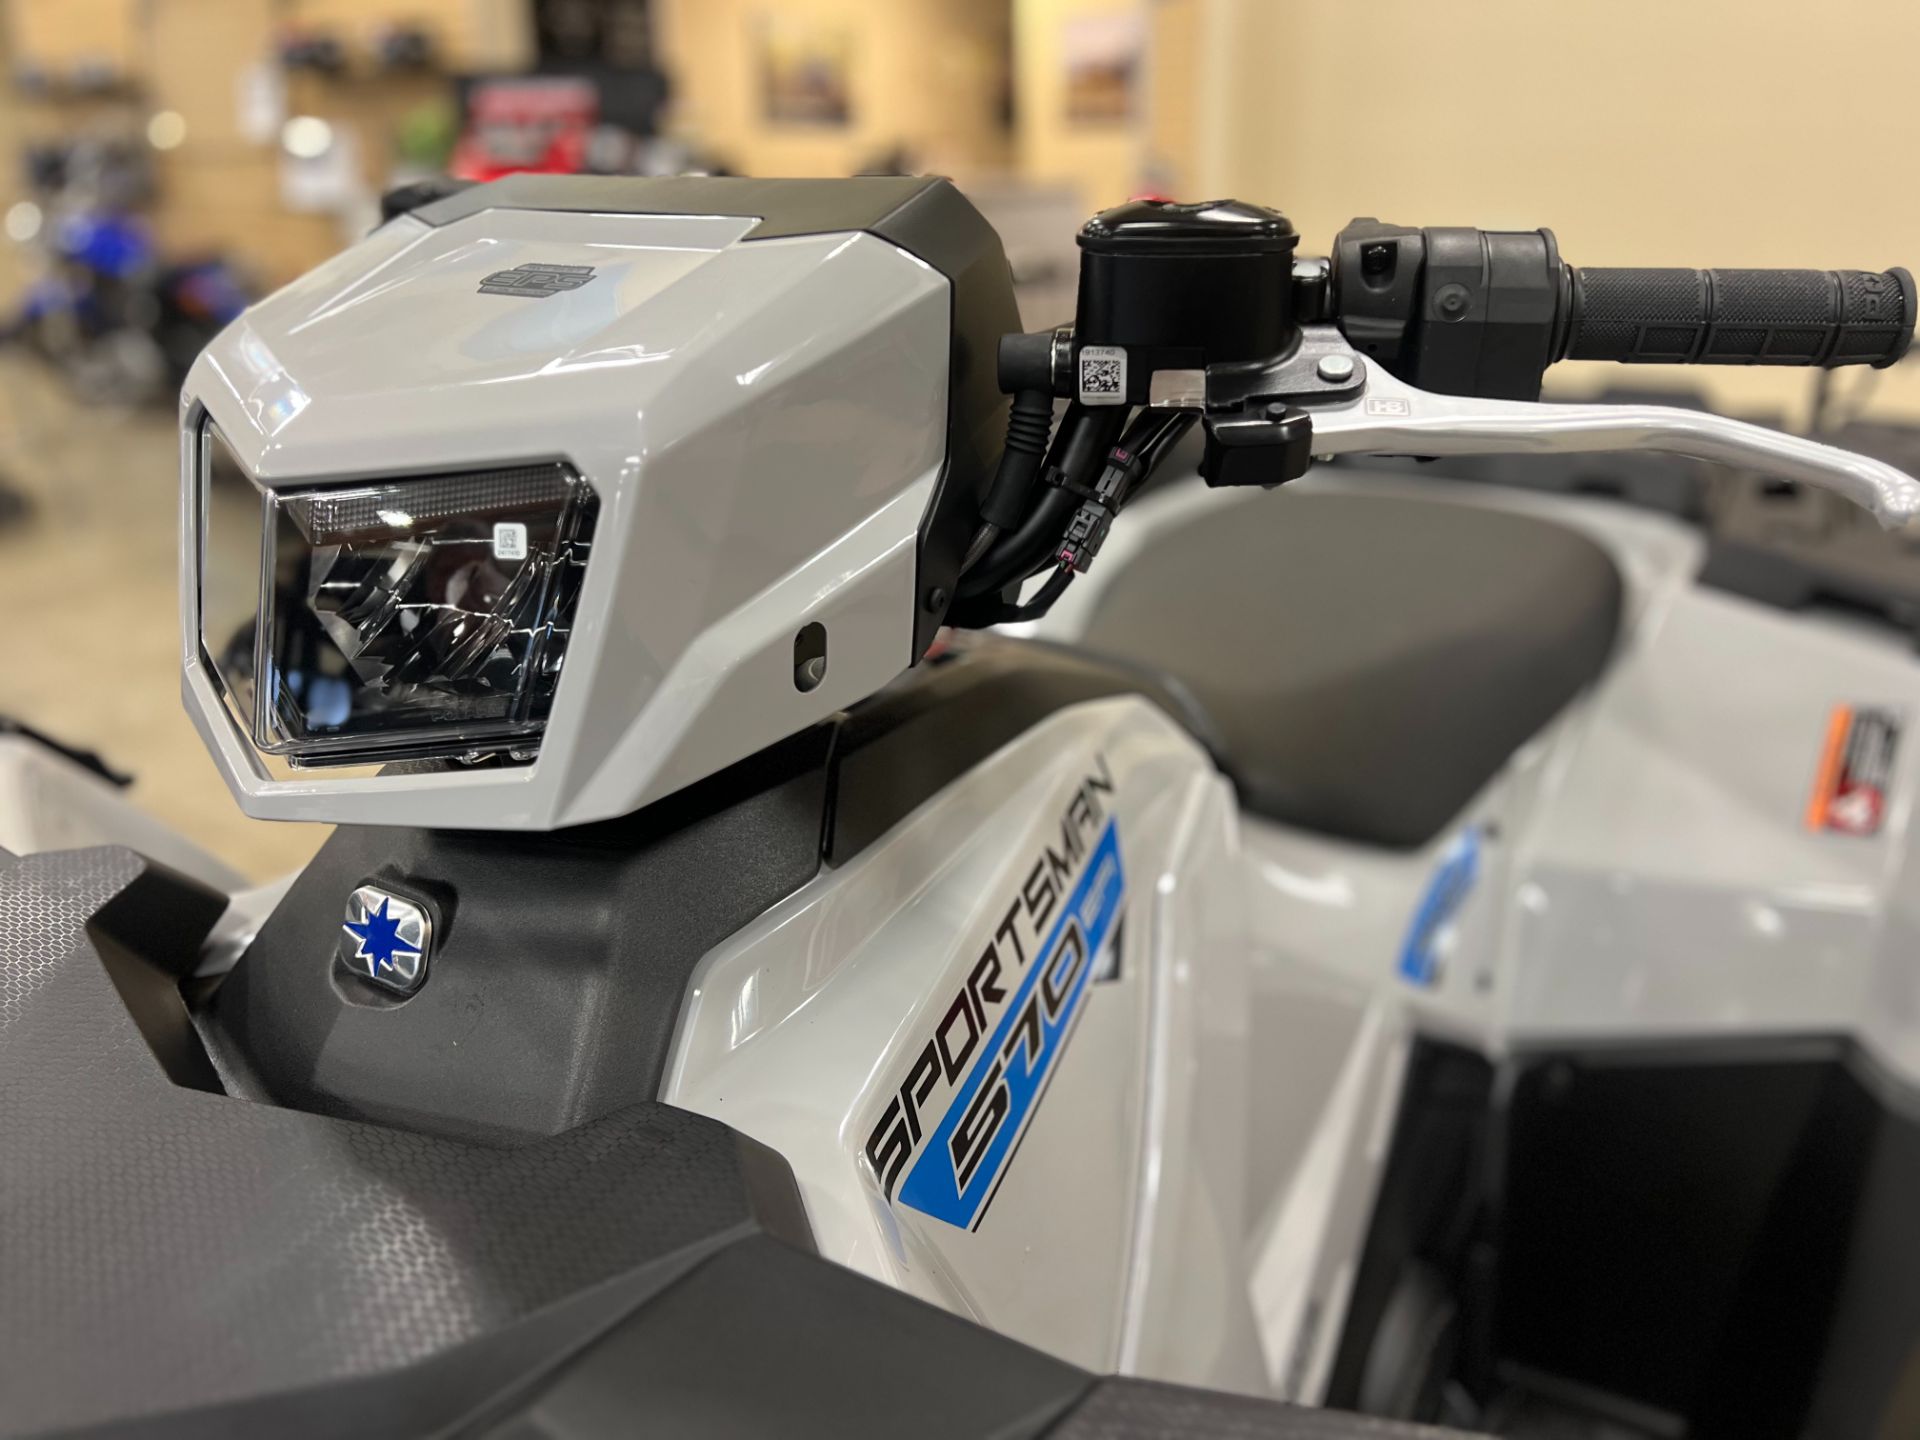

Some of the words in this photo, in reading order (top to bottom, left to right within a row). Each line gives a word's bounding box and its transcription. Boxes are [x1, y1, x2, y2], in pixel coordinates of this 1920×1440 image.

[481, 269, 597, 291] EPS
[866, 755, 1117, 1204] SPORTSMAN
[951, 918, 1088, 1196] 570
